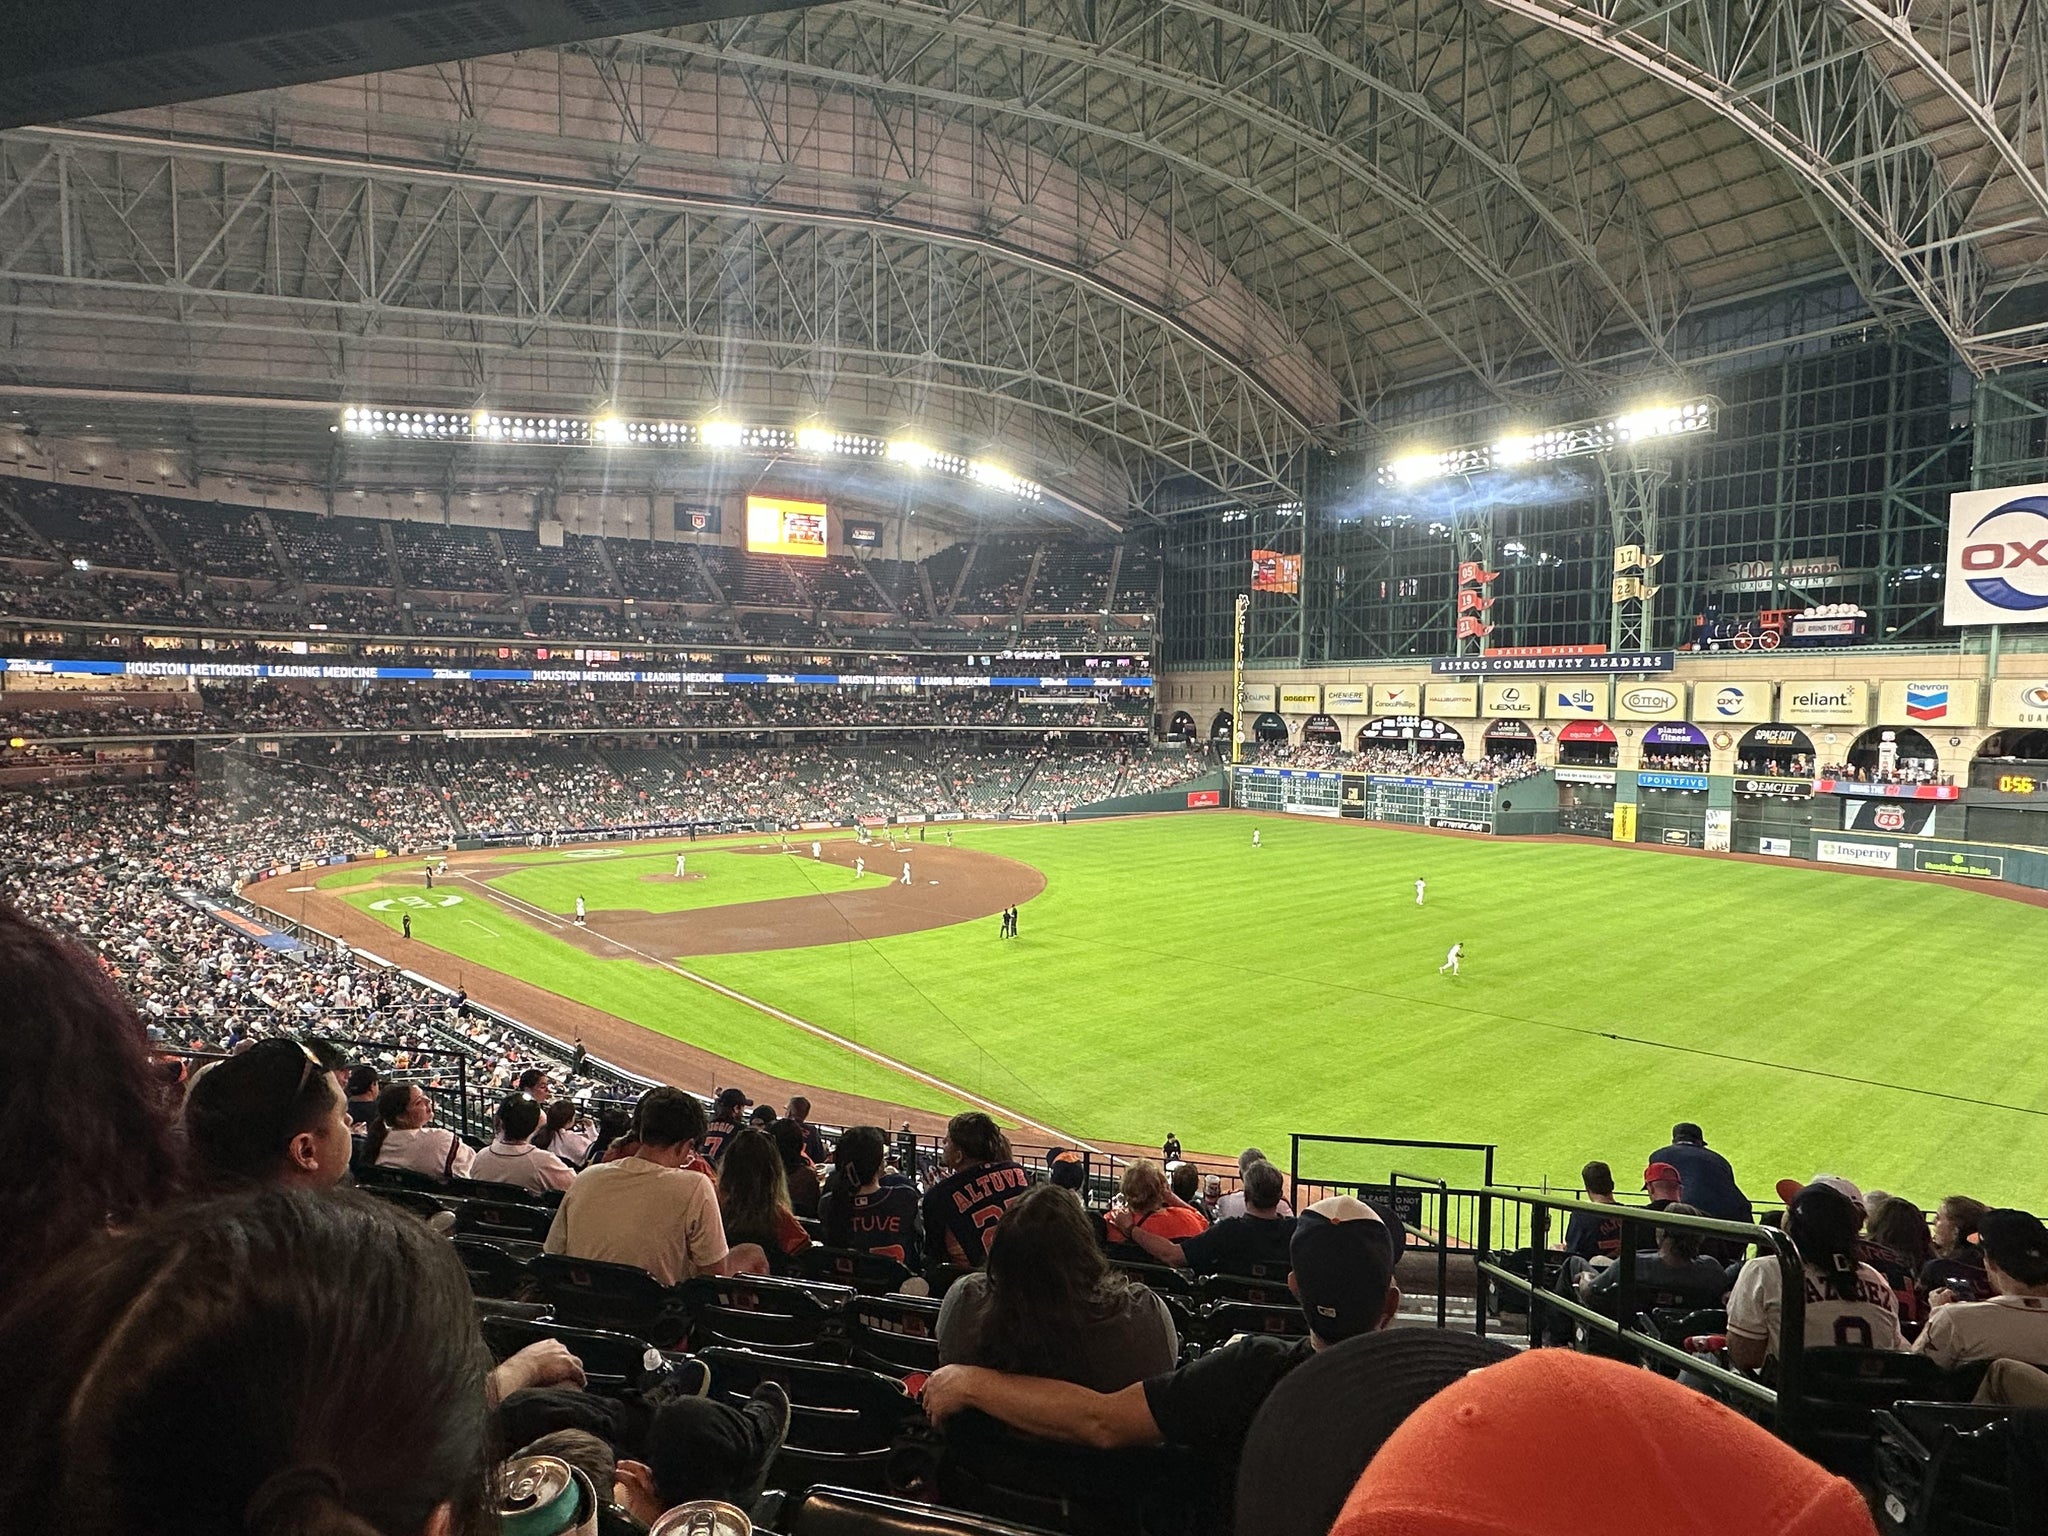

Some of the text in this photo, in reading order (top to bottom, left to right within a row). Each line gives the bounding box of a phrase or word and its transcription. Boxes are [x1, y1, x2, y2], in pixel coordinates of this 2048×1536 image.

[1620, 550, 1633, 564] 17
[1462, 566, 1473, 578] 05
[1617, 582, 1631, 594] 22
[1734, 580, 1774, 589] LUXUR
[1462, 595, 1472, 606] 19
[1460, 621, 1470, 631] 21
[1440, 656, 1662, 671] ASTROS COMMUNITY LEADERS
[126, 662, 378, 678] HOUSTON METHODIST LEADING MEDICINE
[533, 670, 724, 682] HOUSTON METHODIST LEADING MEDICINE
[1907, 683, 1948, 691] Chevron
[1572, 689, 1594, 703] slb
[1629, 694, 1668, 708] COTTON
[1793, 692, 1848, 706] reliant
[2019, 713, 2048, 722] QUA
[1657, 726, 1686, 735] planet
[1755, 730, 1797, 740] SPACE CITY
[1661, 733, 1692, 741] fitness
[1642, 776, 1704, 787] 1POINTFIVE
[1880, 814, 1900, 826] 66
[1837, 844, 1890, 861] Insperity
[704, 1136, 723, 1158] 7
[952, 1168, 1028, 1214] ALTUVE
[852, 1215, 900, 1233] TUVE
